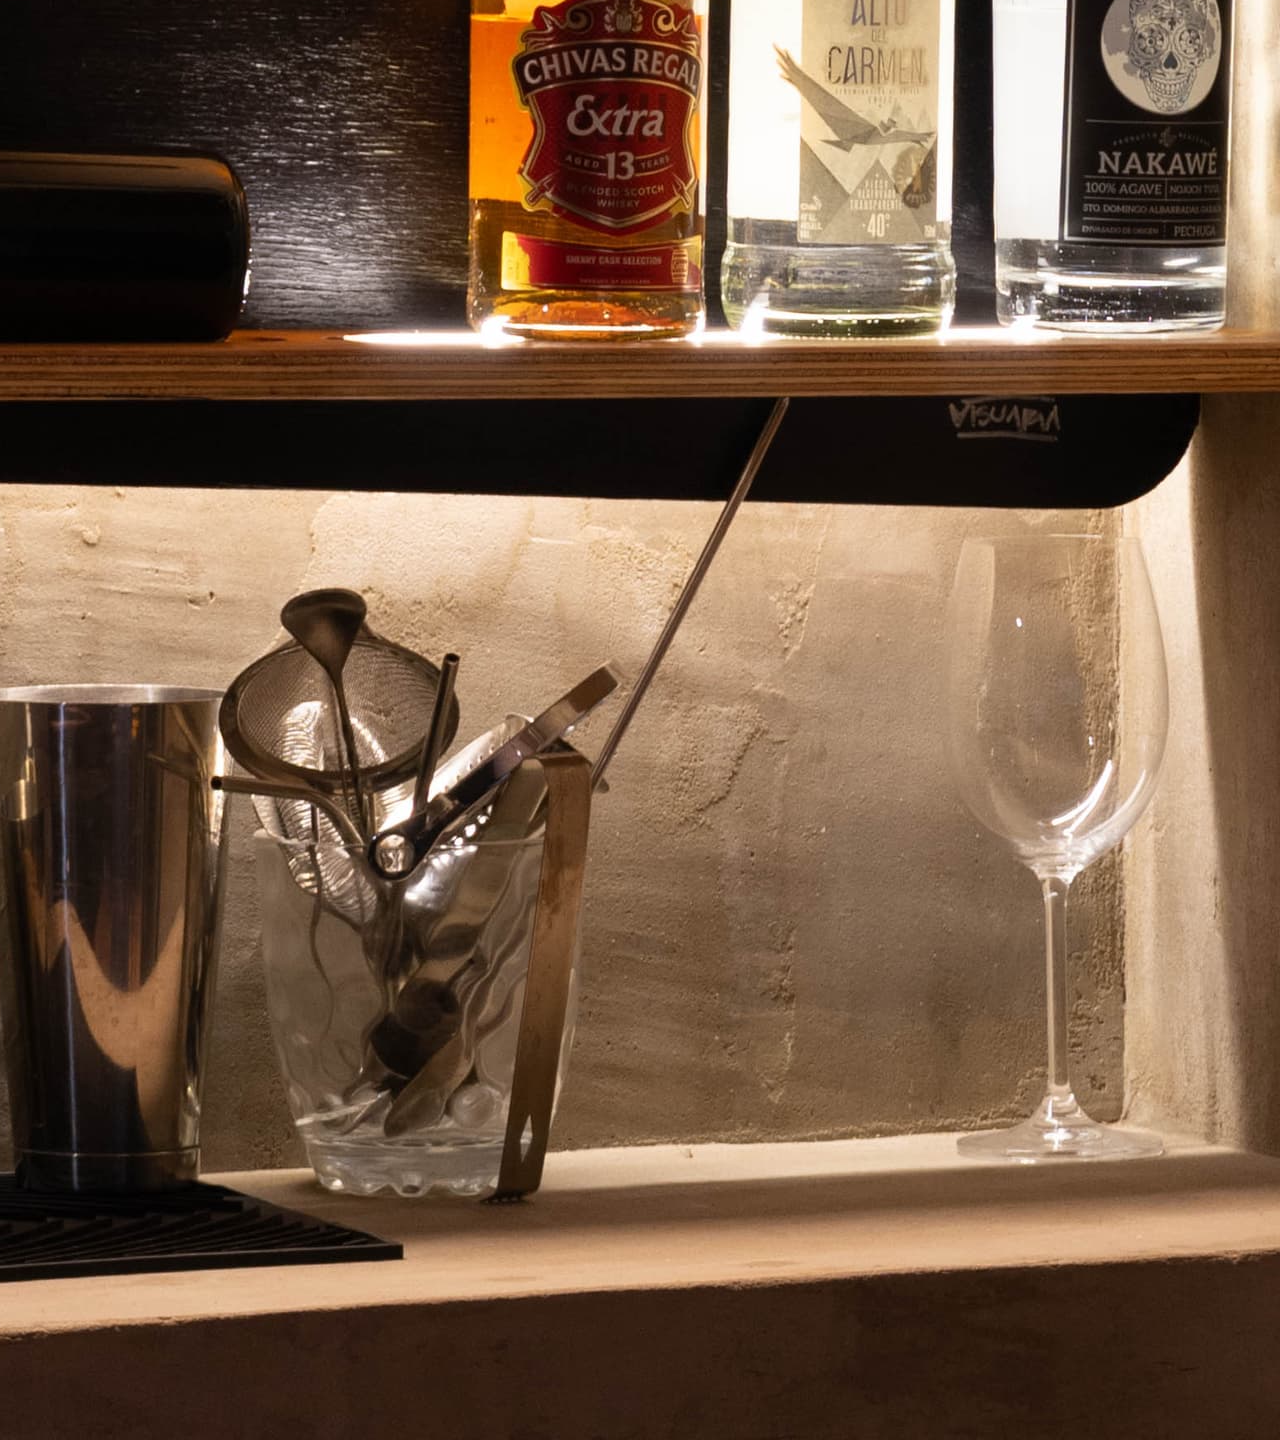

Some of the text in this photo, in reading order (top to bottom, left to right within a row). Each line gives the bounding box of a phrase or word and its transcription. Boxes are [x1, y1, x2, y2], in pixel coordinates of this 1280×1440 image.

[524, 47, 698, 91] CHIVAS REGAL
[827, 45, 924, 85] CARMEN
[566, 94, 665, 137] Extra
[565, 151, 671, 180] AGED 13 YEARS
[1097, 146, 1218, 176] NAKAWÉ
[623, 184, 665, 197] SCOTCH
[1085, 181, 1117, 195] 100%
[1119, 183, 1163, 196] AGAVE
[596, 198, 641, 209] WHISKY
[1173, 224, 1217, 238] PECHUGA
[598, 254, 621, 265] CASK
[622, 256, 663, 266] SELECTION
